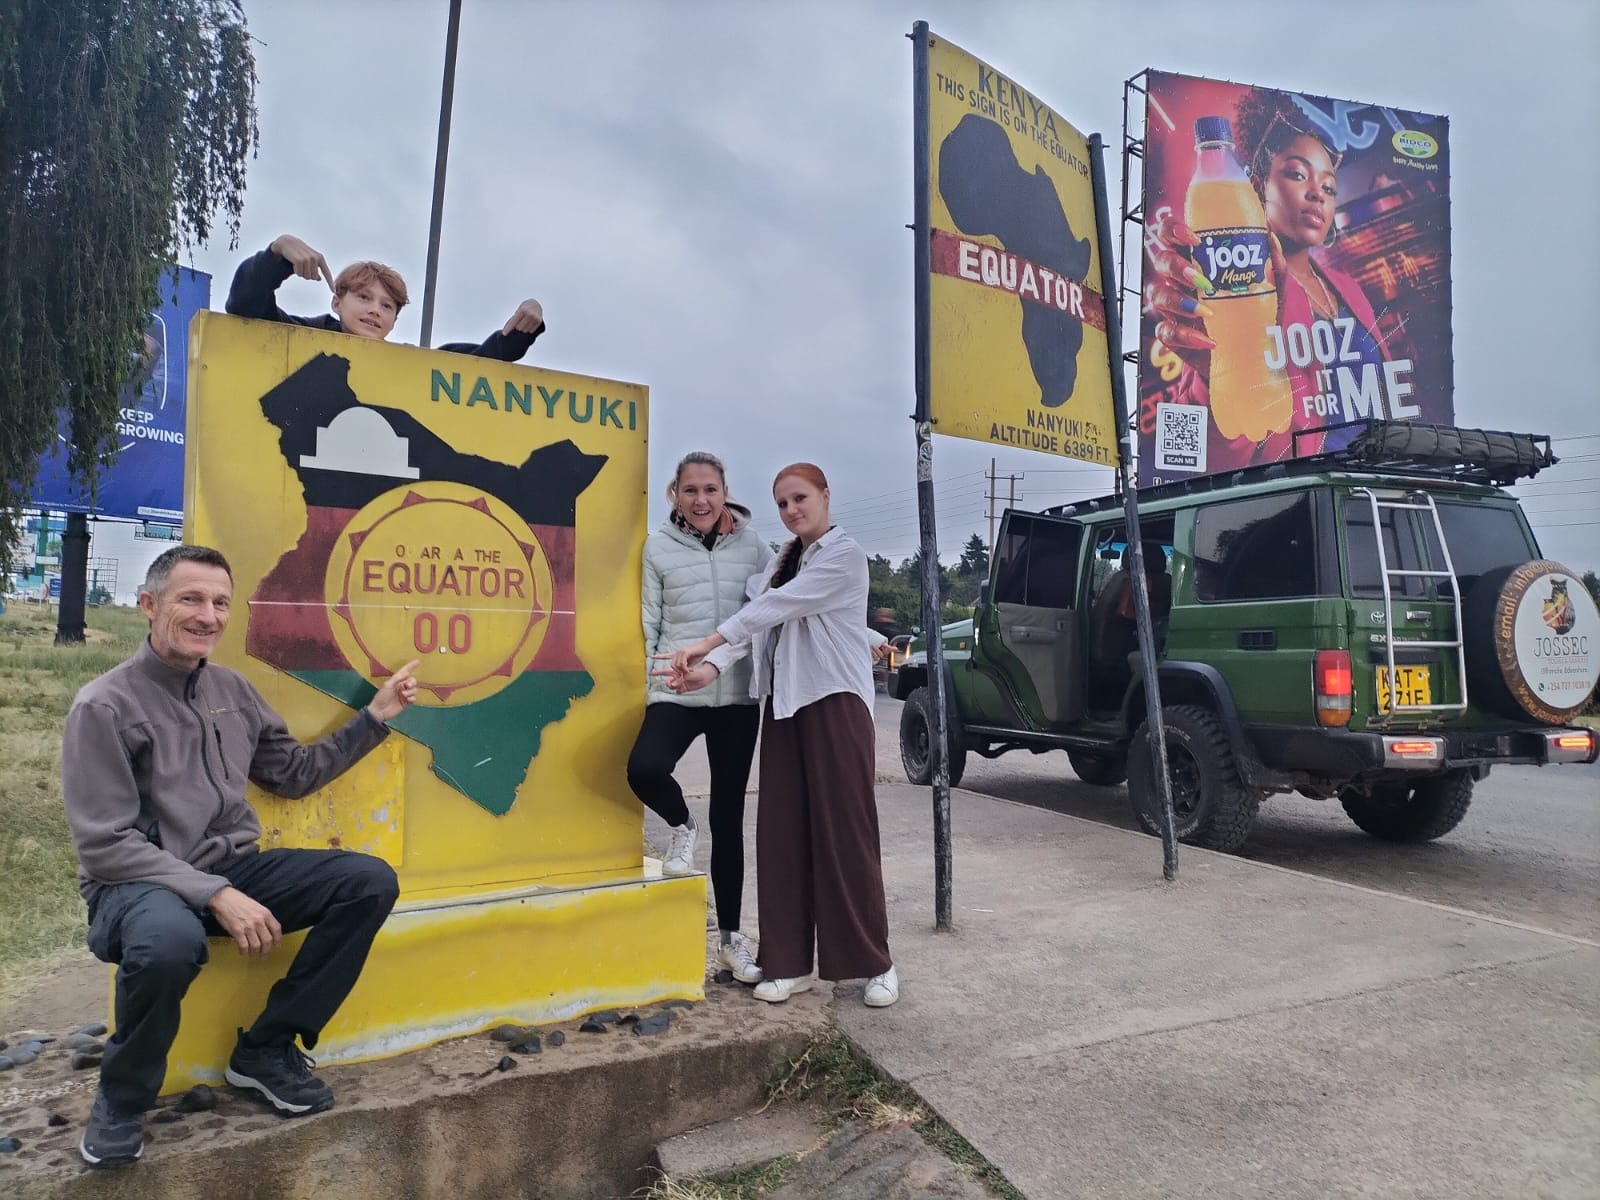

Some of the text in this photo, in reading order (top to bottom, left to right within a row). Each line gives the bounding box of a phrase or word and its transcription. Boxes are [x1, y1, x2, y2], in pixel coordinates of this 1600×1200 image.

[936, 73, 965, 101] THIS
[969, 90, 996, 119] SIGN
[999, 108, 1010, 126] IS
[1014, 119, 1028, 136] ON
[1030, 127, 1048, 151] THE
[977, 63, 1060, 141] KENYA
[959, 240, 1086, 319] EQUATOR
[1221, 268, 1257, 284] Mango
[1263, 317, 1361, 371] JOOZ
[1315, 368, 1334, 392] IT
[1336, 358, 1422, 422] ME
[431, 368, 637, 431] NANYUKI
[1302, 393, 1340, 419] FOR
[118, 407, 154, 424] KEEP
[1026, 408, 1083, 439] NANYUKI
[115, 422, 184, 445] GROWING
[990, 422, 1059, 452] ALTITUDE
[1166, 456, 1195, 465] SCAN ME
[474, 549, 502, 564] THE
[362, 559, 526, 598] EQUATOR
[1533, 635, 1589, 657] JOSSEC
[1381, 669, 1413, 689] KAT
